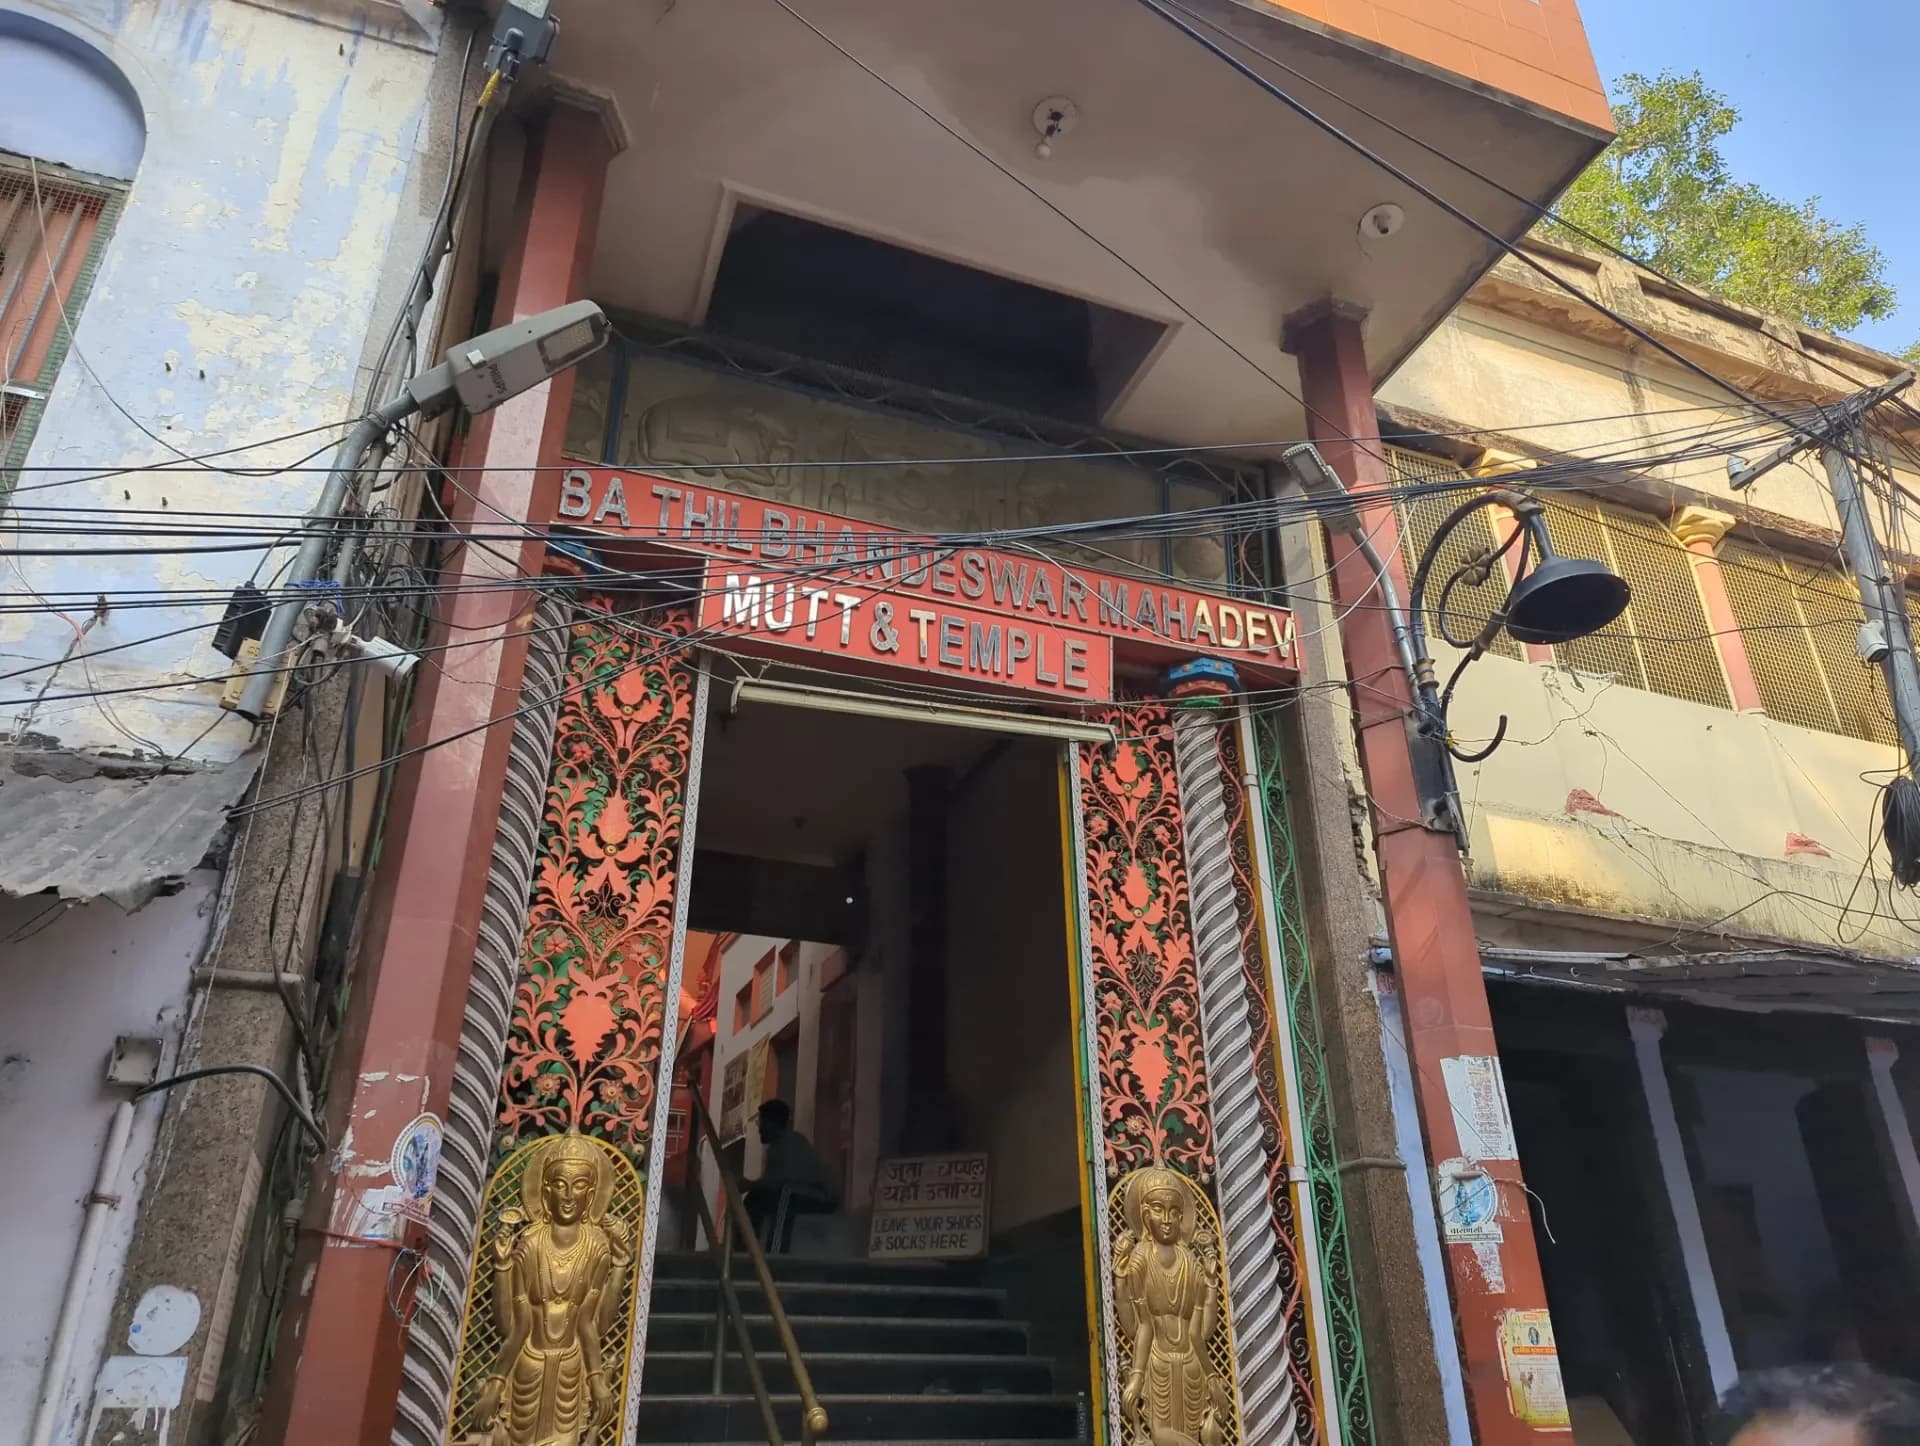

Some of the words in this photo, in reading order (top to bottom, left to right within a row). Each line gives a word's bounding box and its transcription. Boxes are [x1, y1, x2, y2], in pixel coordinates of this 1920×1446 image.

[722, 572, 861, 647] MUTT
[870, 602, 900, 654] &
[909, 608, 1090, 690] TEMPLE
[1100, 580, 1294, 659] MAHADEV
[874, 1216, 910, 1233] LEAVE
[914, 1215, 943, 1231] YOUR
[945, 1214, 982, 1231] SHOES
[886, 1234, 927, 1250] SOCKS
[930, 1232, 968, 1249] HERE
